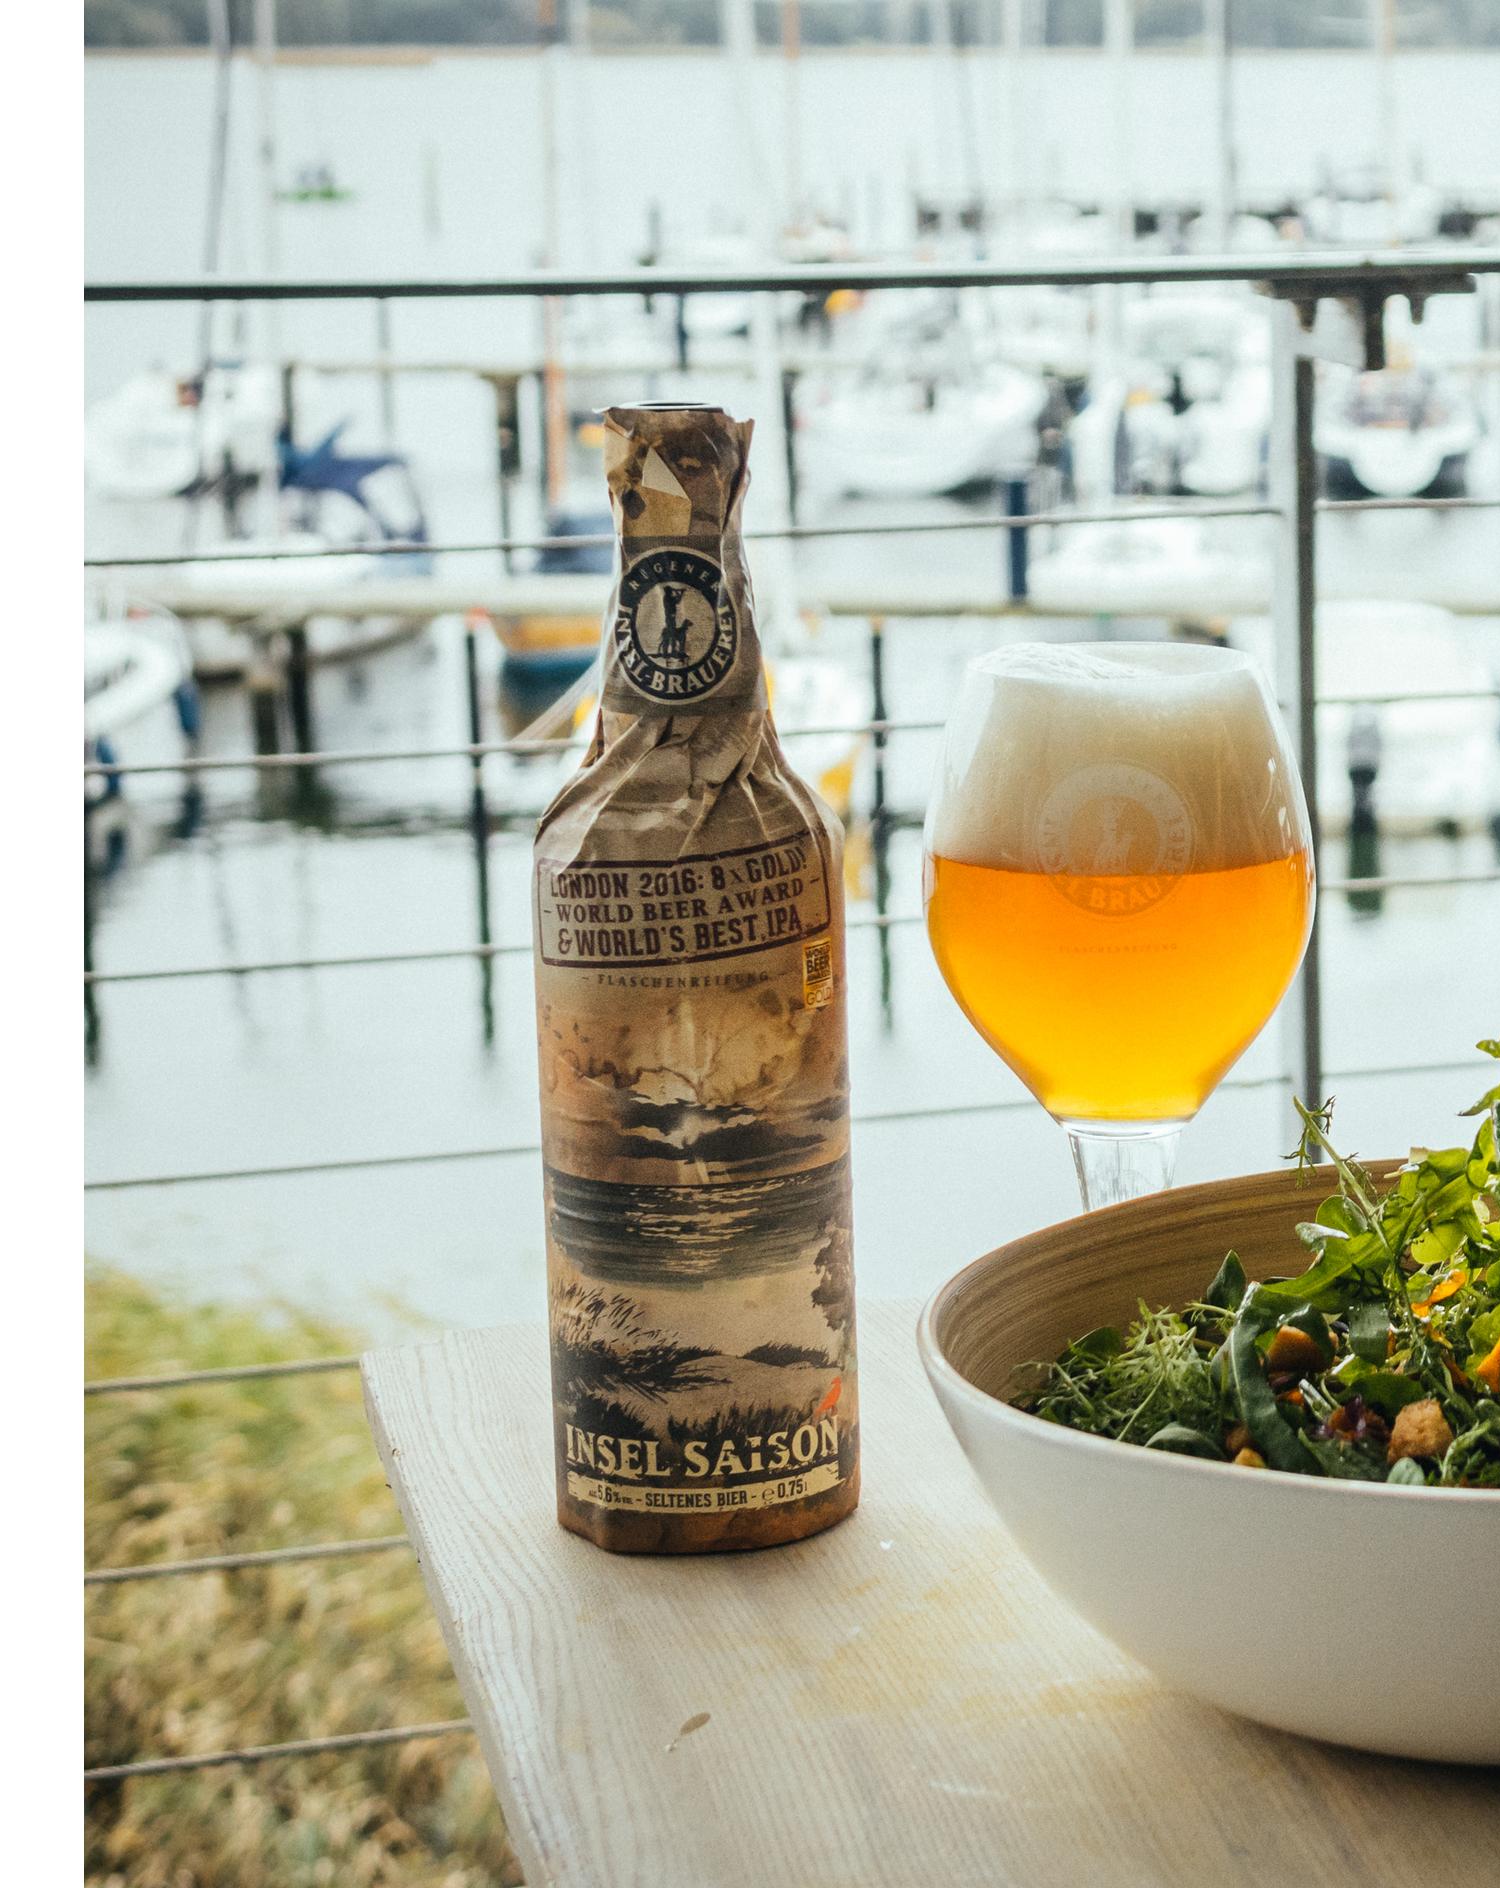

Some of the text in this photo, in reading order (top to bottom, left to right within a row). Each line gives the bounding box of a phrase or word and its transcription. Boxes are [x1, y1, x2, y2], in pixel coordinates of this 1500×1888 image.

[551, 871, 629, 899] LONDON
[639, 867, 704, 898] 2016:
[556, 878, 804, 923] WORLD BEER AWARD
[574, 925, 686, 957] WORLD'S
[766, 903, 802, 937] IPA
[597, 971, 769, 988] FLASCHENREIFUNG
[807, 986, 831, 1005] GOLD
[565, 1415, 839, 1480] INSEL SAISON
[645, 1492, 712, 1509] SELTENES
[717, 1489, 748, 1507] BIER
